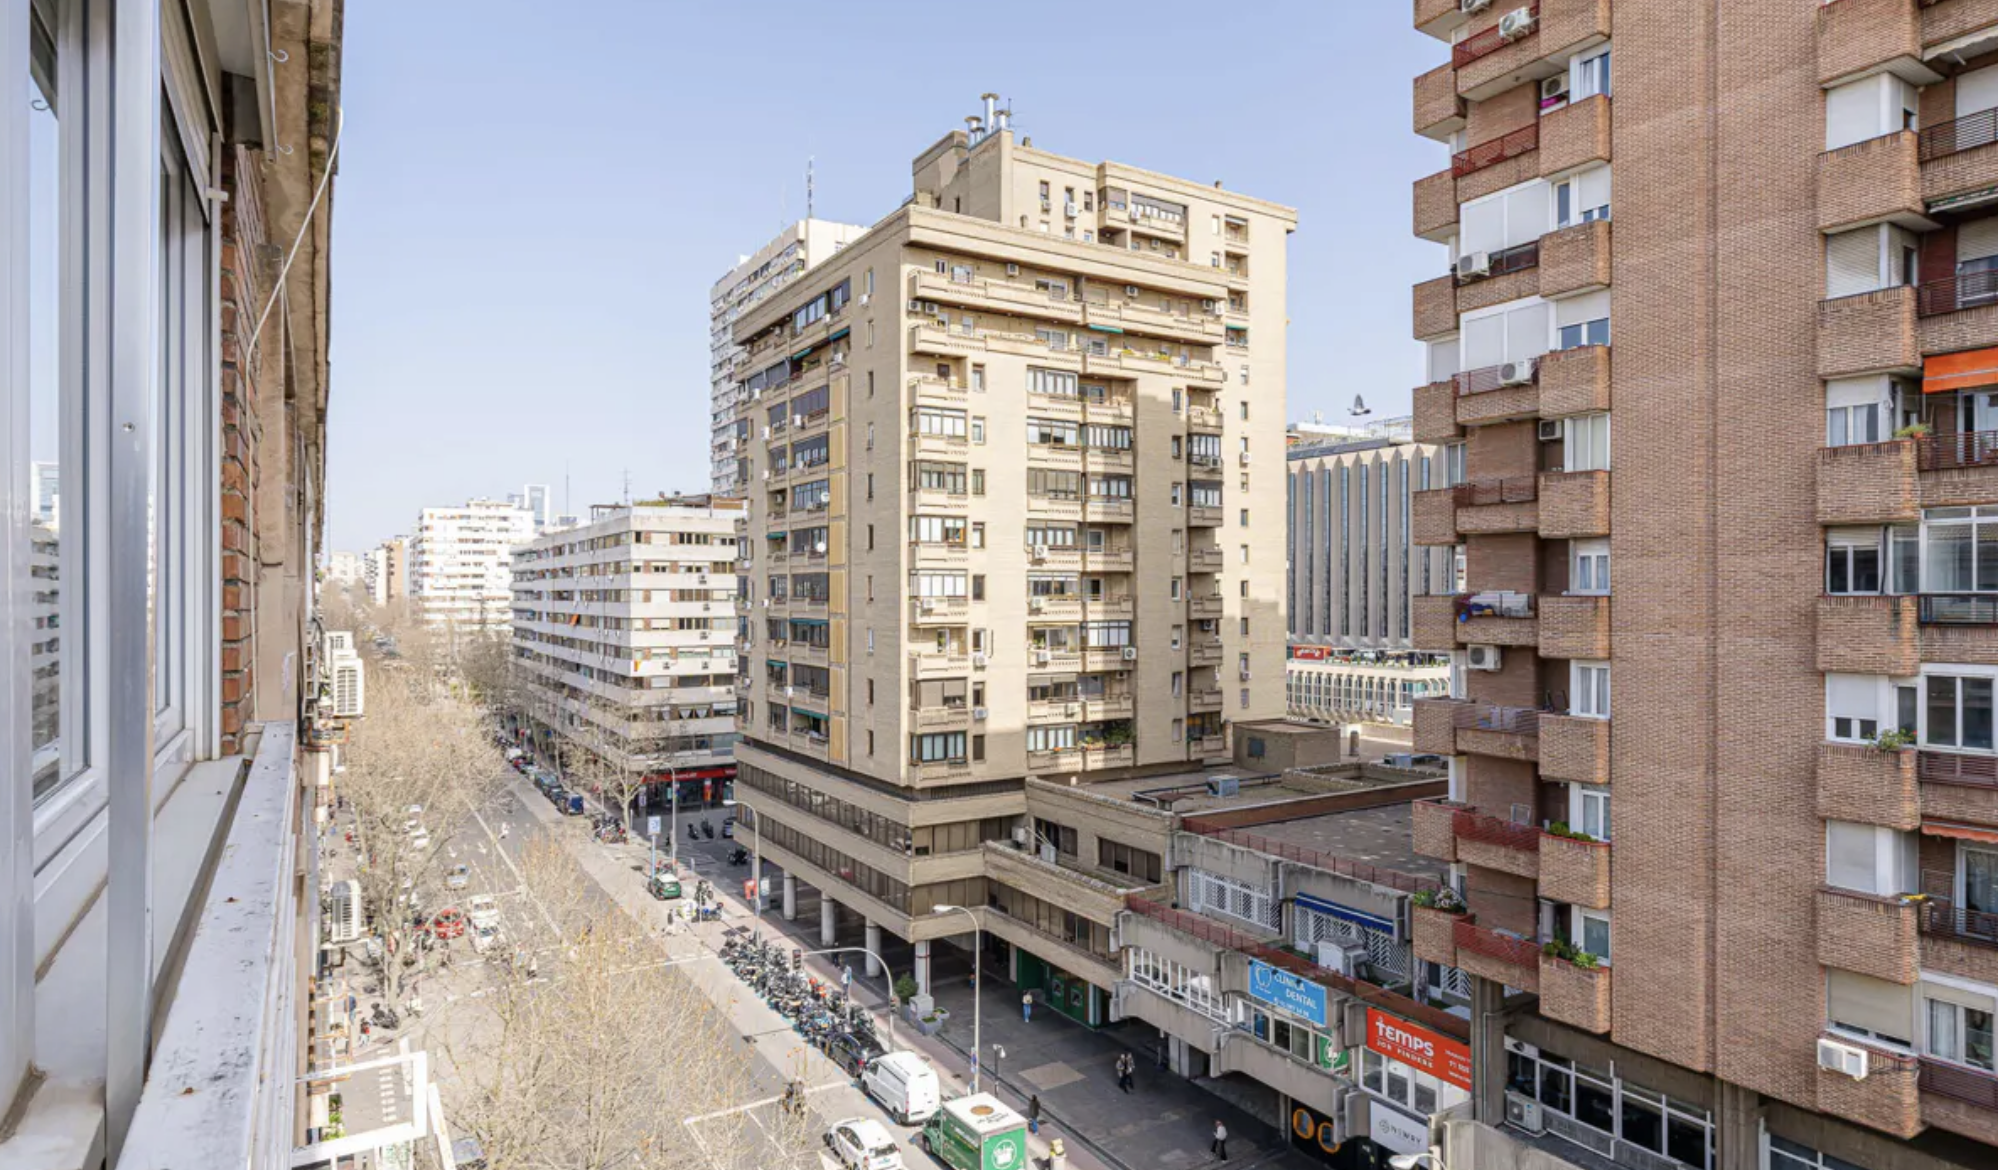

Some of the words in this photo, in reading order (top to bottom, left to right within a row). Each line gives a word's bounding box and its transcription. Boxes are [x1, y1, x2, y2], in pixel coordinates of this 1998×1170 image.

[1286, 988, 1318, 1010] DENTAL
[1377, 1039, 1392, 1051] JOB
[1397, 1046, 1434, 1069] FINDERS
